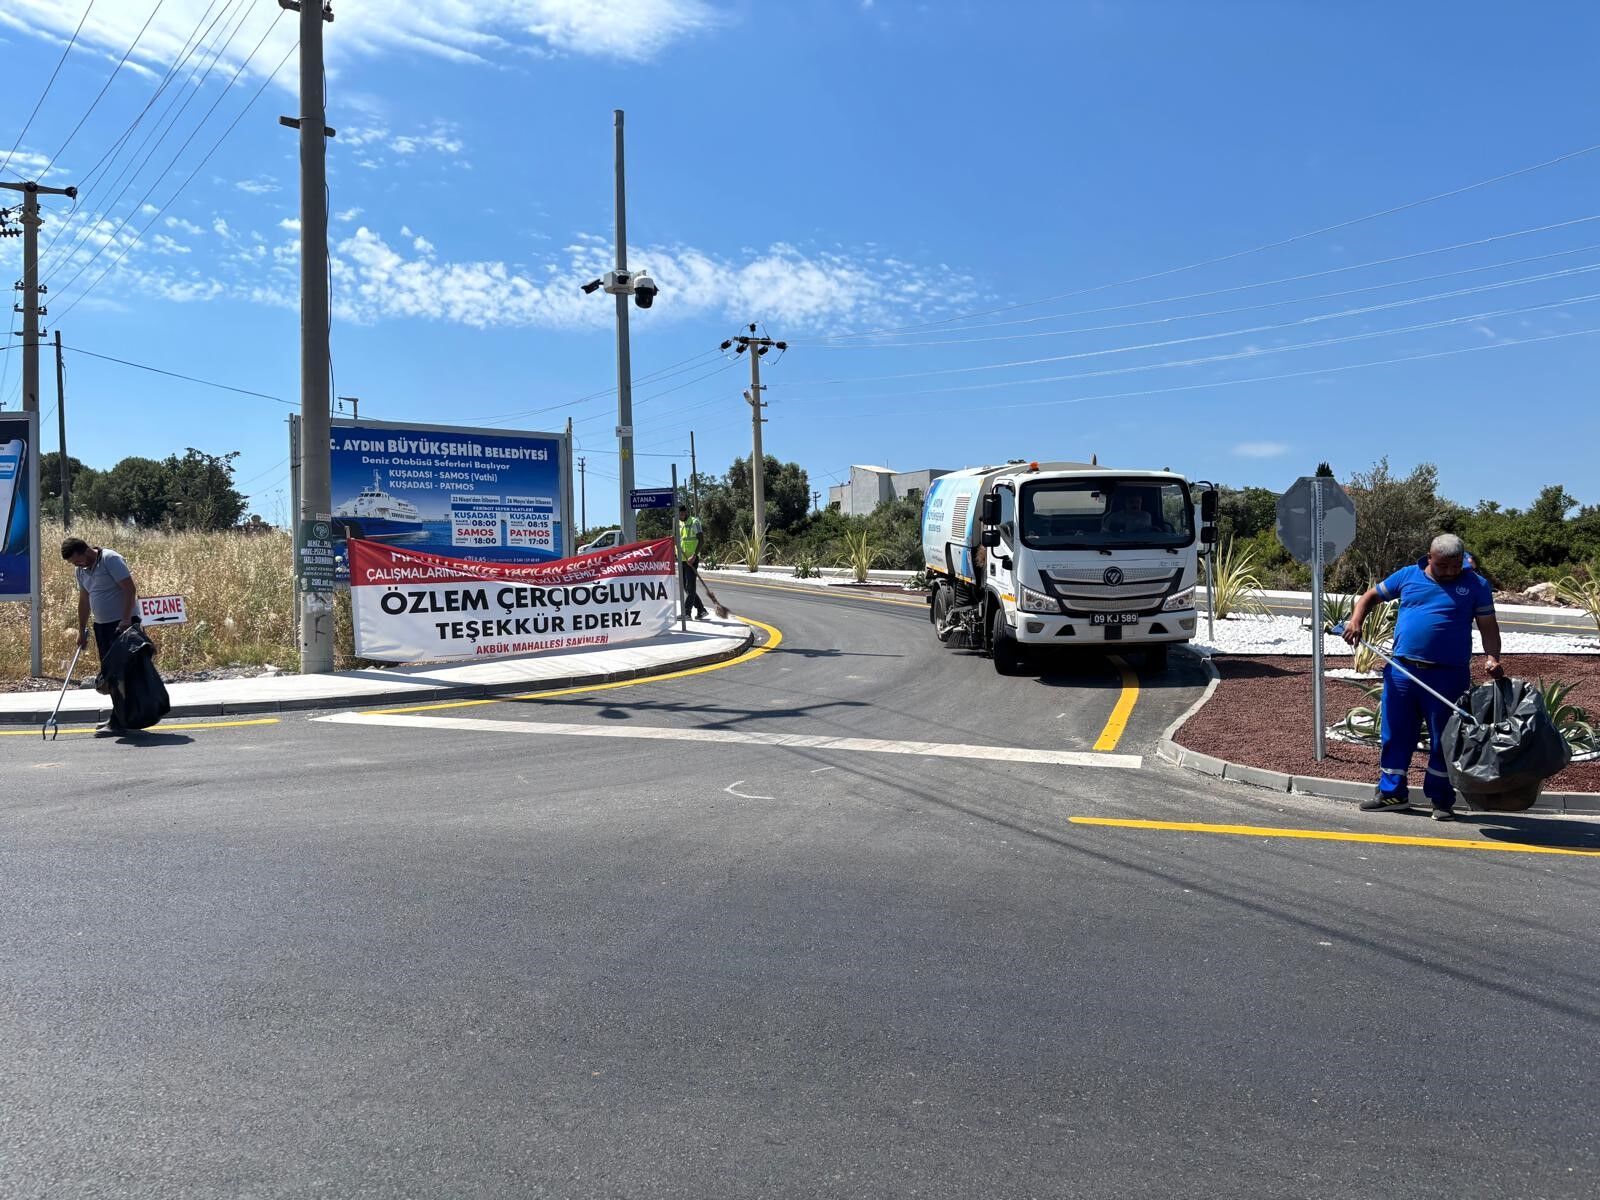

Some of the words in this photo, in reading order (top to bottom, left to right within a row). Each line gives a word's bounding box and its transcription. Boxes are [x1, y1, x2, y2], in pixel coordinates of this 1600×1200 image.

[344, 440, 385, 452] AYDIN
[387, 437, 482, 458] BÜYÜKŞEHİR
[485, 446, 548, 460] BELEDİYESİ
[362, 456, 389, 464] Deniz
[392, 457, 432, 466] Otobüsü
[434, 459, 473, 468] Seferleri
[474, 461, 510, 470] Başlıyor
[389, 469, 433, 479] KUŞADASI
[440, 472, 469, 480] SAMOS
[471, 472, 498, 483] (Vathi)
[389, 481, 433, 490] KUŞADASI
[454, 512, 497, 520] KUŞADASI
[566, 557, 607, 573] SICAK
[600, 564, 628, 575] SAYIN
[628, 561, 671, 573] BAŞKANIMIZ
[142, 598, 182, 616] ECZANE
[380, 586, 489, 615] ÖZLEM
[436, 613, 566, 643] TEŞEKKÜR
[573, 609, 642, 631] EDERİZ
[1094, 615, 1106, 623] 09
[1107, 615, 1120, 623] KJ
[1121, 614, 1138, 622] 589
[476, 642, 509, 655] AKBÜK
[512, 637, 563, 652] MAHALLESİ
